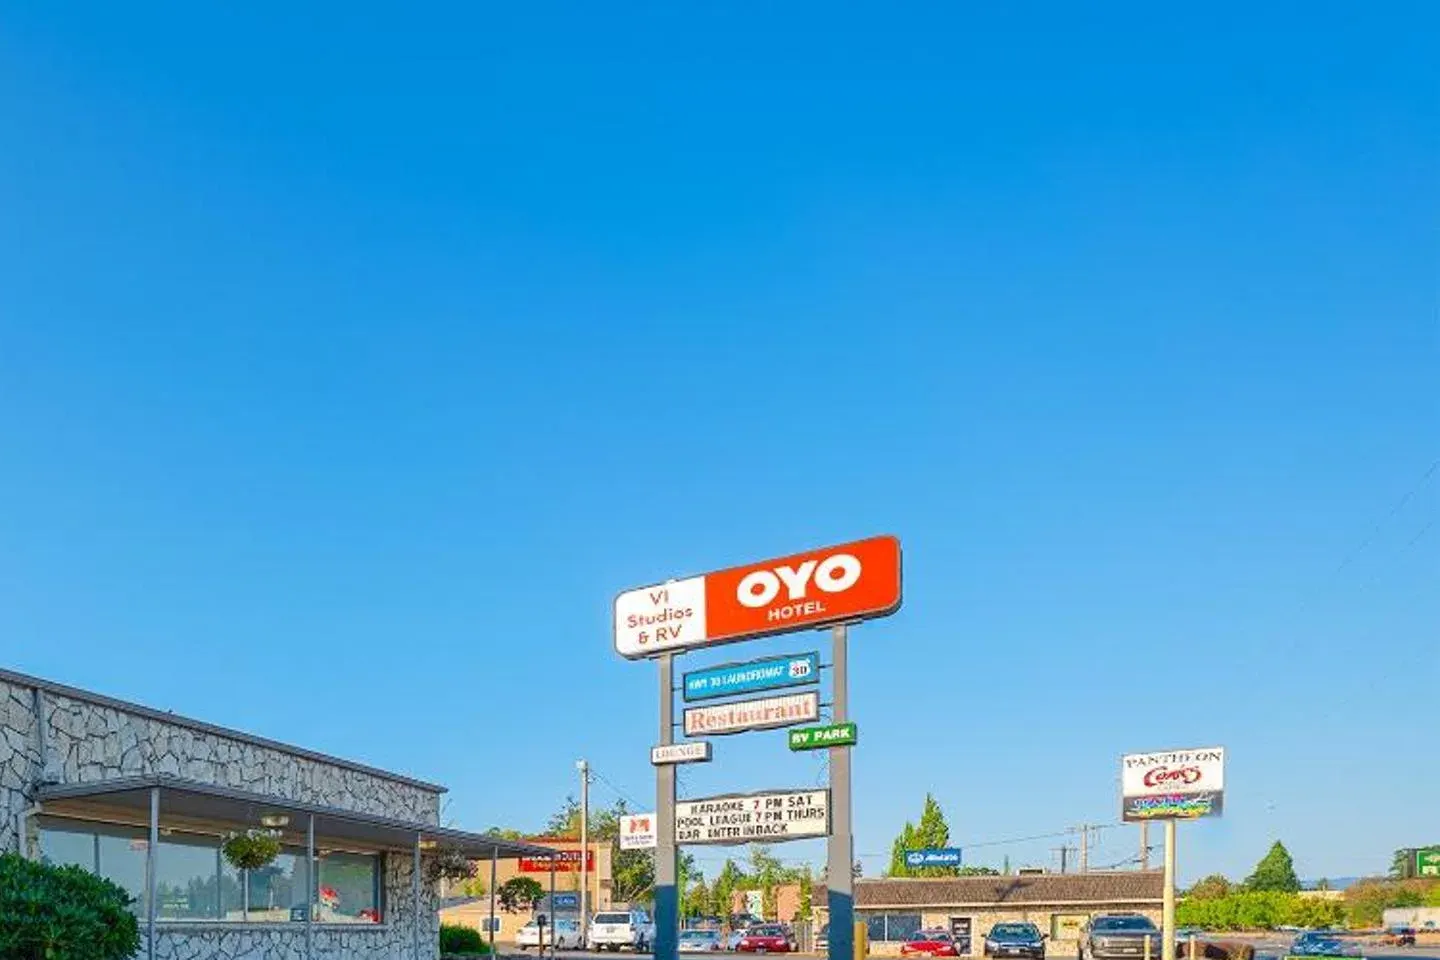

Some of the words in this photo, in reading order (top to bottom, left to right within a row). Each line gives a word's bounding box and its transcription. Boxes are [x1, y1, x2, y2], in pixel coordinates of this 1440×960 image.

[736, 554, 862, 608] OYO
[649, 589, 669, 606] VI
[627, 607, 694, 629] Studios
[767, 600, 826, 622] HOTEL
[638, 631, 650, 645] &
[655, 624, 683, 642] RV
[689, 699, 812, 731] Restaurant
[791, 732, 810, 744] RV
[814, 728, 851, 742] PARK
[1125, 751, 1222, 769] PANTHEON
[690, 801, 745, 815] KARAOKE
[753, 800, 760, 810] 7
[765, 798, 783, 809] PM
[788, 795, 814, 808] SAT
[677, 816, 706, 829] POOL
[710, 811, 752, 826] LEAGUE
[765, 810, 783, 822] PM
[787, 807, 825, 821] THURS
[678, 828, 701, 840] BAR
[707, 826, 741, 838] ENTER
